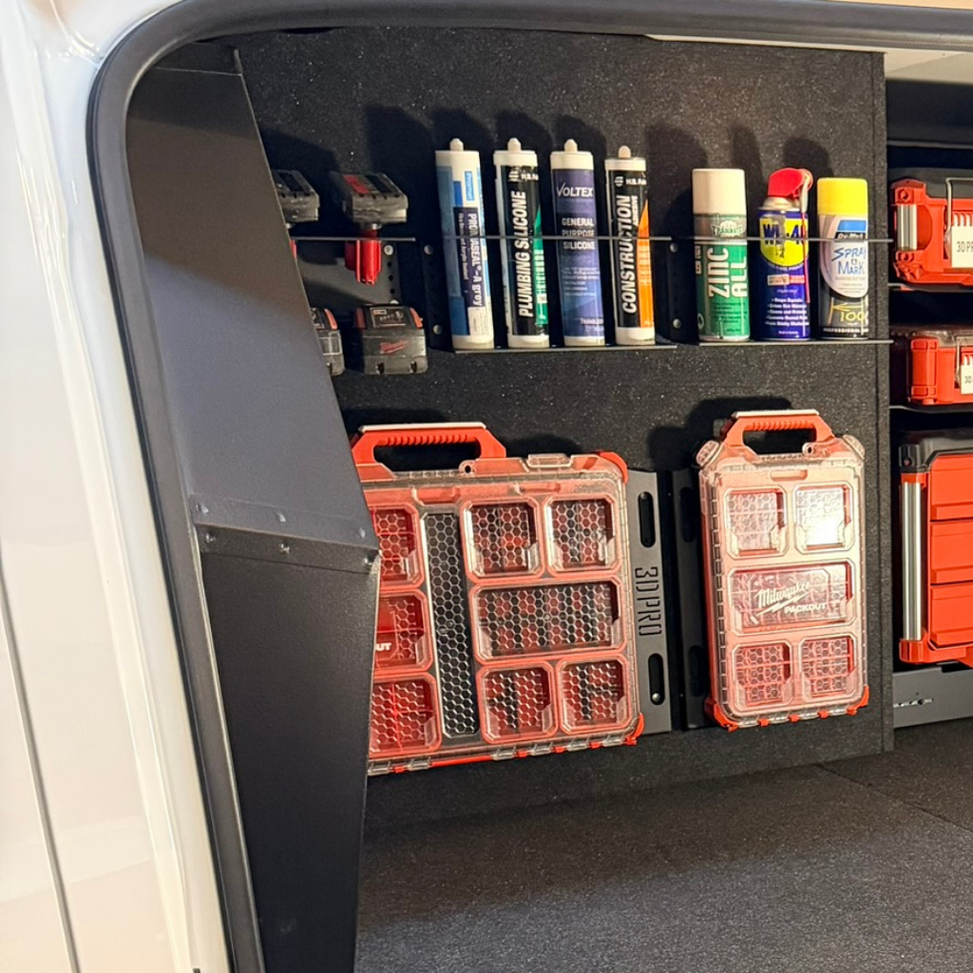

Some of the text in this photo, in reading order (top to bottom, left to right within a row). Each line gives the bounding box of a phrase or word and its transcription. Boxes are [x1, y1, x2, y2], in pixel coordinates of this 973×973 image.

[556, 182, 594, 197] VOLTEX
[562, 218, 594, 227] GENERAL
[562, 230, 595, 238] PURPOSE
[510, 191, 534, 317] PLUMBING SILICONE
[563, 241, 596, 250] SILICONE
[616, 195, 637, 314] CONSTRUCTION
[707, 247, 730, 298] ZINC
[730, 256, 748, 298] ALL
[634, 567, 662, 636] 3DPRO
[754, 581, 811, 609] Milwaukee
[784, 603, 827, 614] PACKOUT
